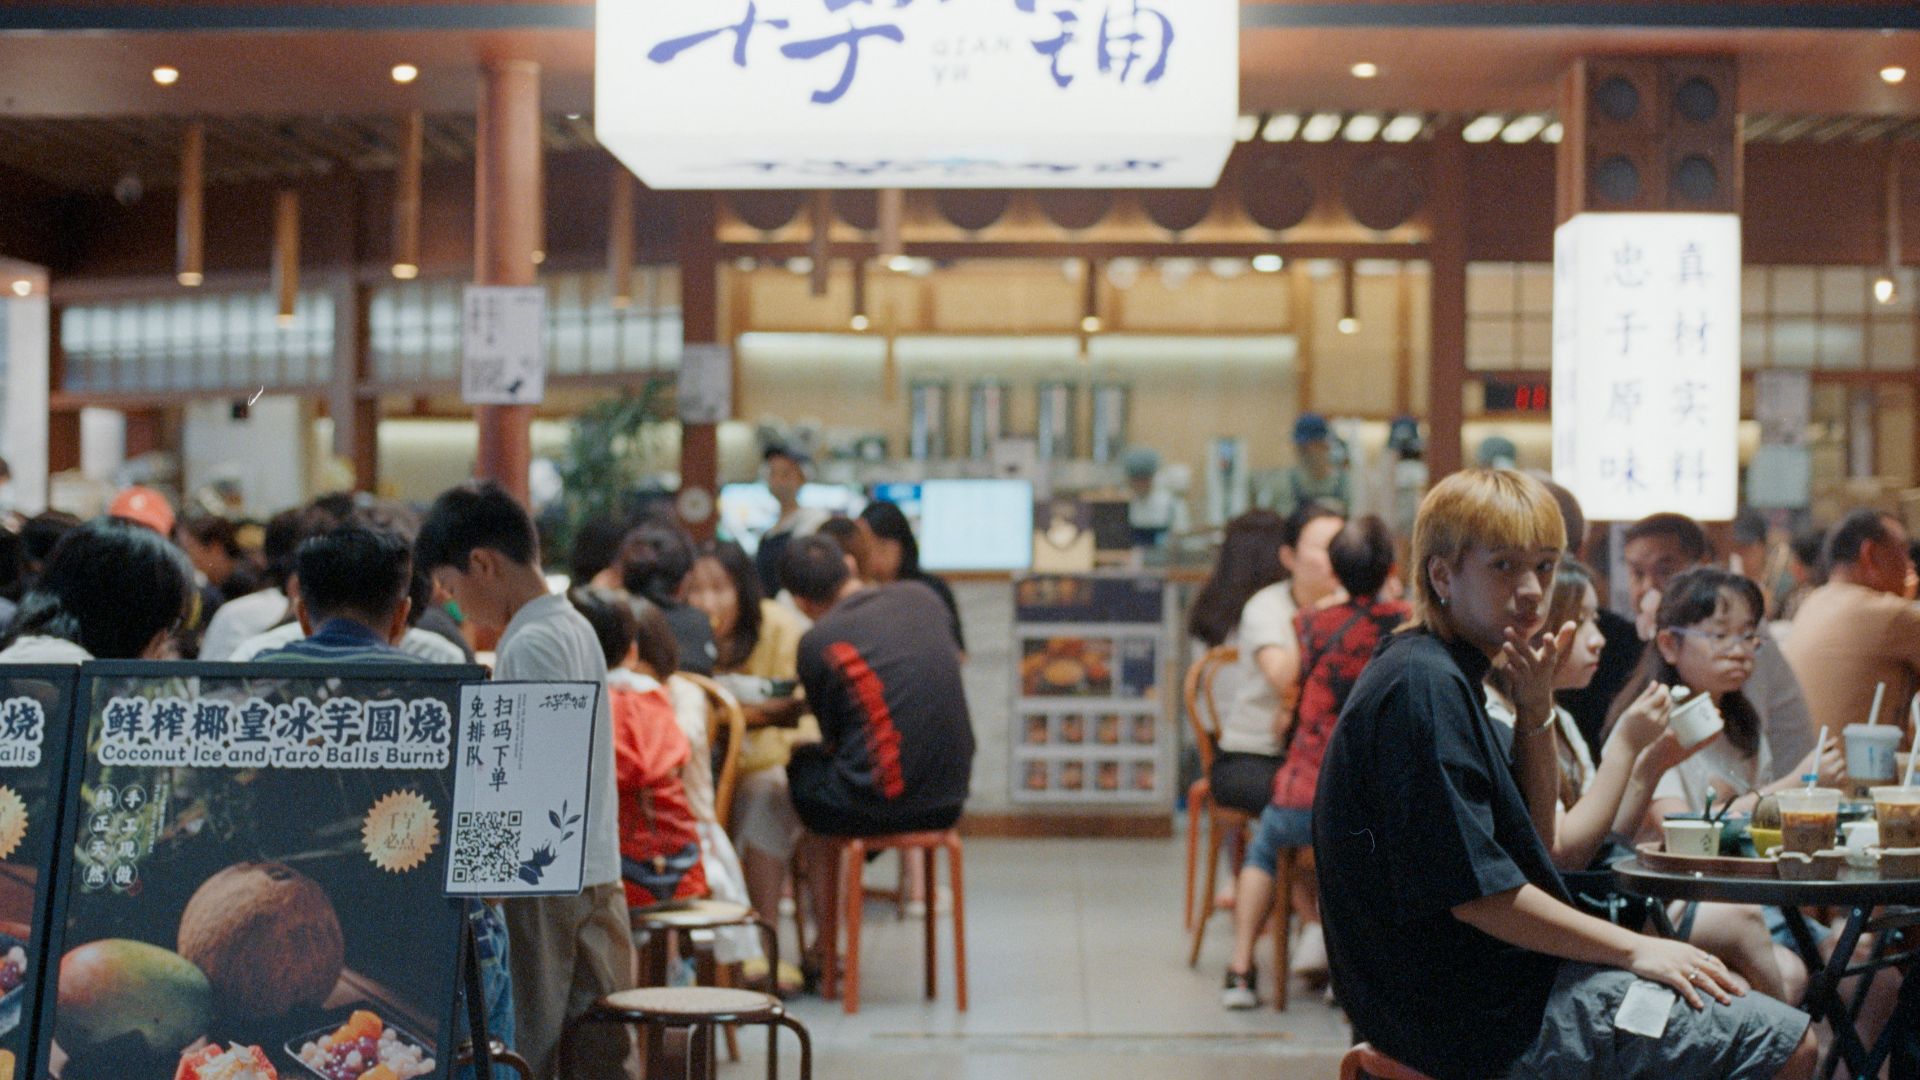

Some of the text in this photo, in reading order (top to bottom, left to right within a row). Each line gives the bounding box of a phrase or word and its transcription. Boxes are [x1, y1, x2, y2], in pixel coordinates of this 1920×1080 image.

[931, 35, 1014, 57] QIAN
[1670, 238, 1715, 497] 真材实料
[104, 701, 448, 744] 鲜榨椰皇冰芋圆烧
[466, 694, 488, 768] 免排队
[488, 694, 514, 792] 扫码下单
[102, 745, 446, 764] Coconut Ice and Taro Balls Burnt
